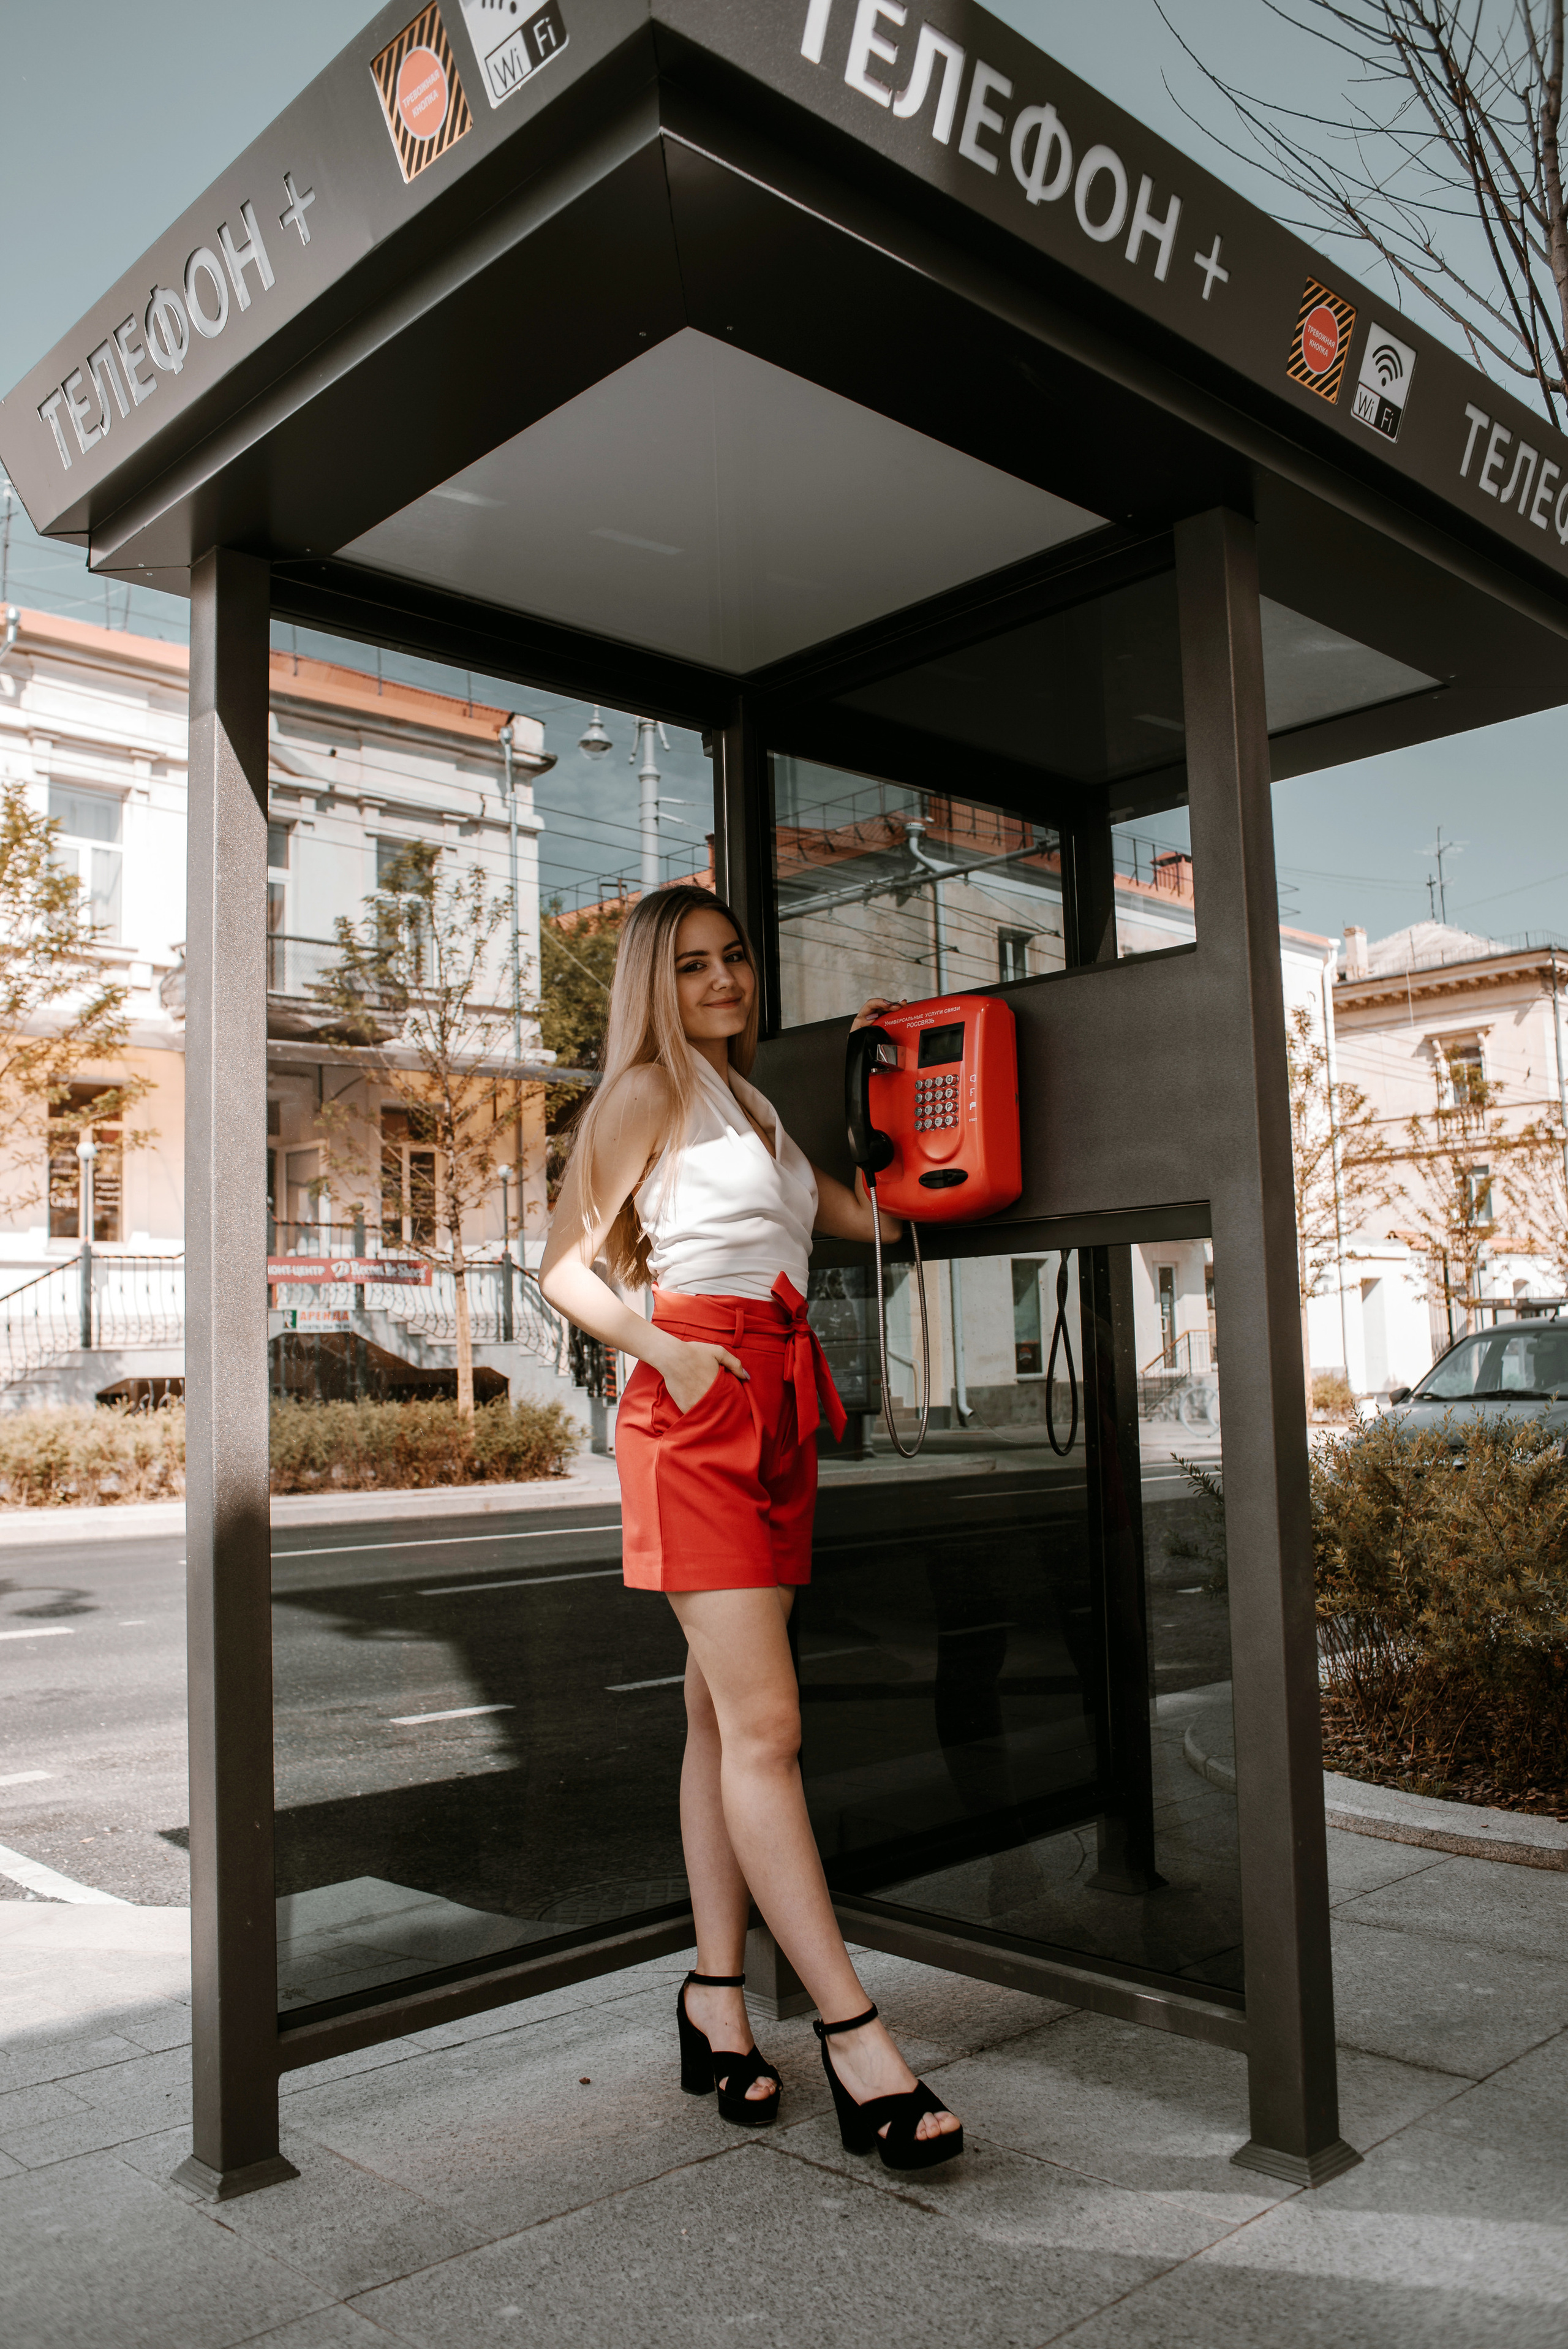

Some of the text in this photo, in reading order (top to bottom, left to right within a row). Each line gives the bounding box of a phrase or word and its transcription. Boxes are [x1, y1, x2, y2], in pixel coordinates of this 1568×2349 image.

[494, 17, 556, 89] Wi Fi
[402, 69, 440, 109] ТРЕВОЖНАЯ
[412, 90, 439, 118] КНОПКА
[36, 199, 276, 471] ТЕЛЕФОН
[1308, 325, 1336, 349] ТРЕВОЖНАЯ
[1309, 339, 1329, 357] КНОПКА
[1358, 392, 1394, 433] Wi Fi
[907, 1018, 935, 1029] РОССВЯЗЬ
[970, 1088, 975, 1097] F
[300, 1311, 349, 1322] АРЕНДА
